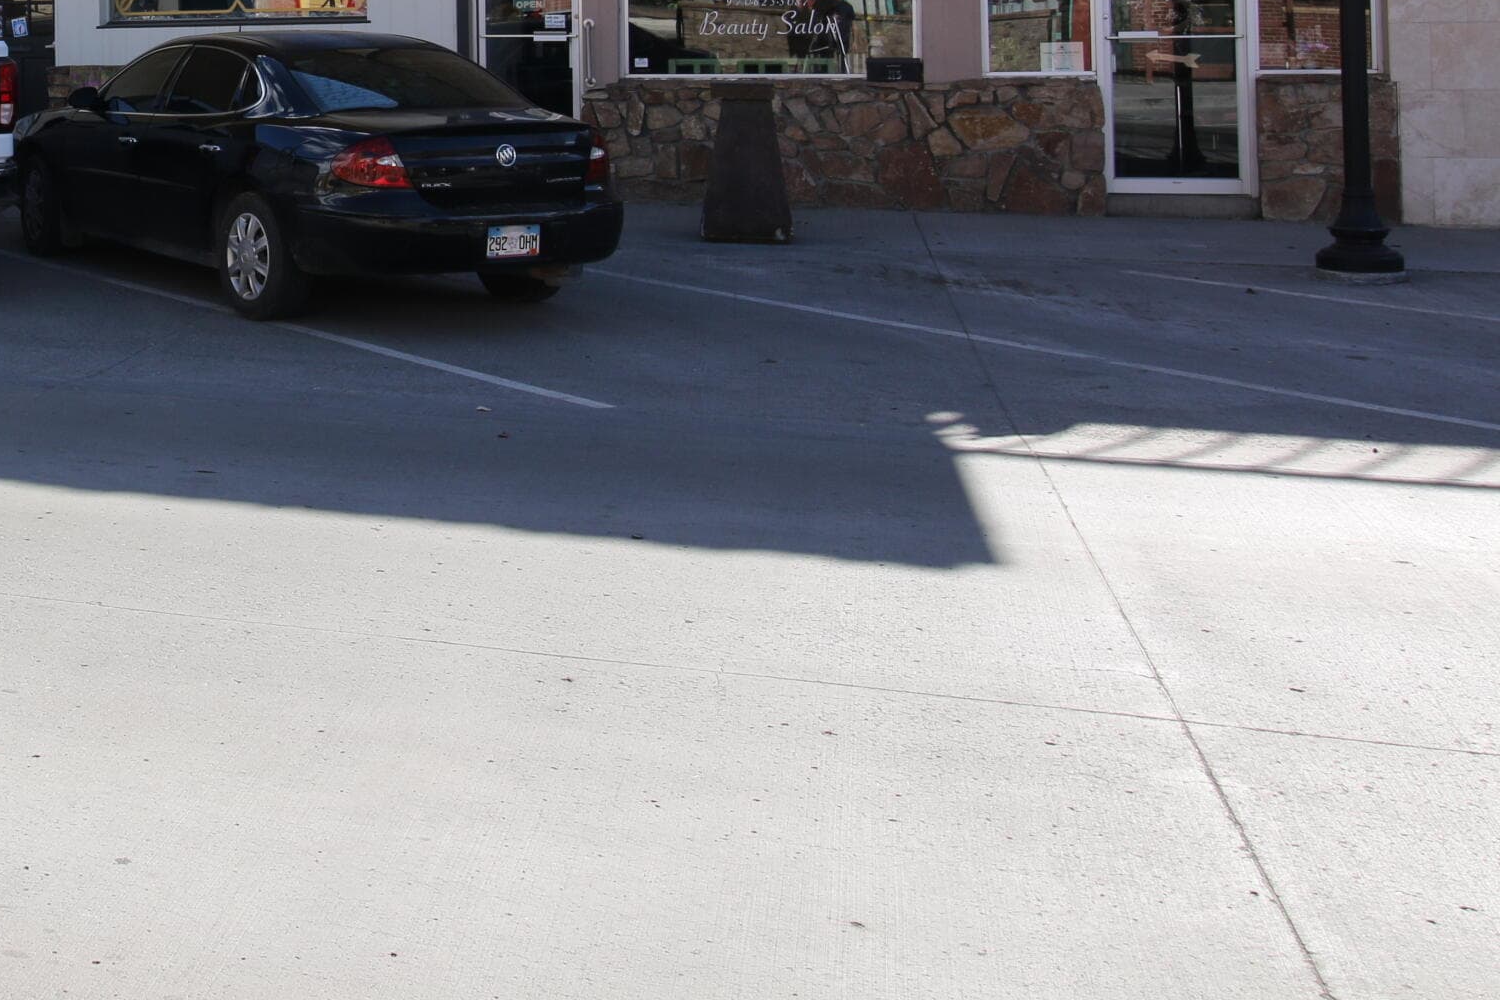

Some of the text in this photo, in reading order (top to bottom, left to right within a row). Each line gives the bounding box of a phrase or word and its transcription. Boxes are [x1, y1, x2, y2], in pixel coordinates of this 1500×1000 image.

[516, 0, 543, 9] OPEN
[700, 10, 838, 41] Beauty Salon
[489, 236, 508, 252] 292
